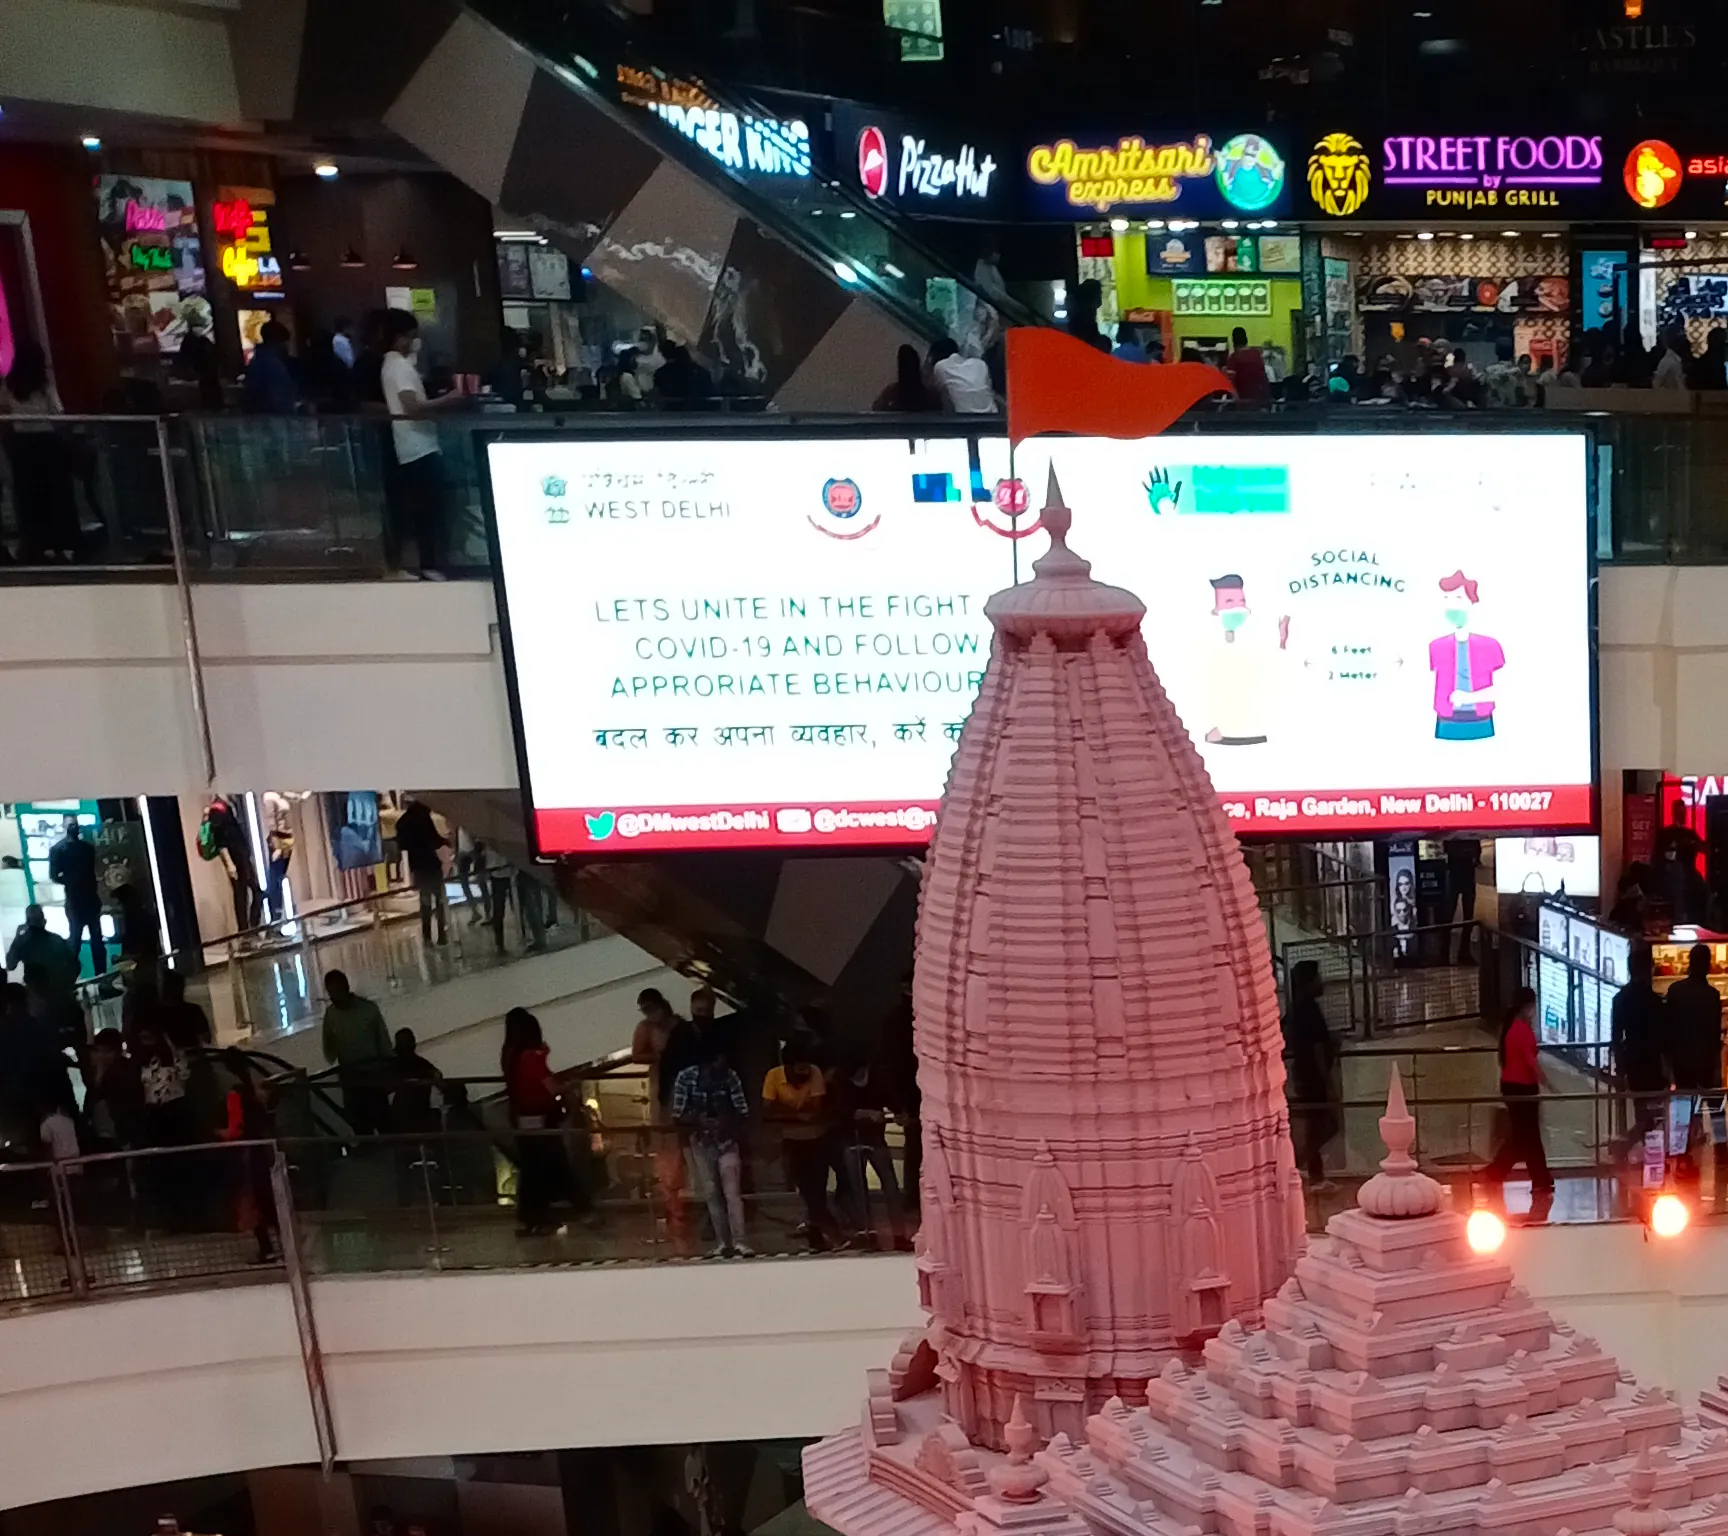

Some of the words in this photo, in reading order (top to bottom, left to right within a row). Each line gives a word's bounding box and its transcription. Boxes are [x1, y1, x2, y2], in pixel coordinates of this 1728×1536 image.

[1029, 136, 1214, 183] Amritsari
[1382, 136, 1492, 171] STREET
[1496, 135, 1603, 170] FOODS
[899, 135, 955, 197] Pizza
[955, 144, 998, 198] Hut
[1482, 173, 1501, 188] by
[1068, 177, 1180, 211] express
[1425, 189, 1499, 210] PUNJAB
[1504, 189, 1560, 206] GRILL
[585, 500, 650, 519] WEST
[662, 500, 731, 519] DELHI
[1311, 549, 1379, 567] SOCIAL
[1289, 571, 1406, 594] DISTANCING
[595, 598, 670, 621] LETS
[681, 597, 769, 620] UNITE
[781, 597, 806, 618] IN
[818, 596, 874, 618] THE
[887, 595, 971, 617] FIGHT
[635, 635, 771, 659] COVID-19
[783, 634, 843, 657] AND
[856, 632, 980, 656] FOLLOW
[611, 673, 802, 698] APPRORIATE
[813, 670, 985, 695] BEHAVIOUR
[592, 728, 649, 750] बदल
[662, 727, 699, 749] कर
[713, 725, 775, 748] अपना
[1254, 797, 1298, 821] Raja
[1426, 792, 1473, 814] Delhi
[1489, 791, 1553, 812] 110027
